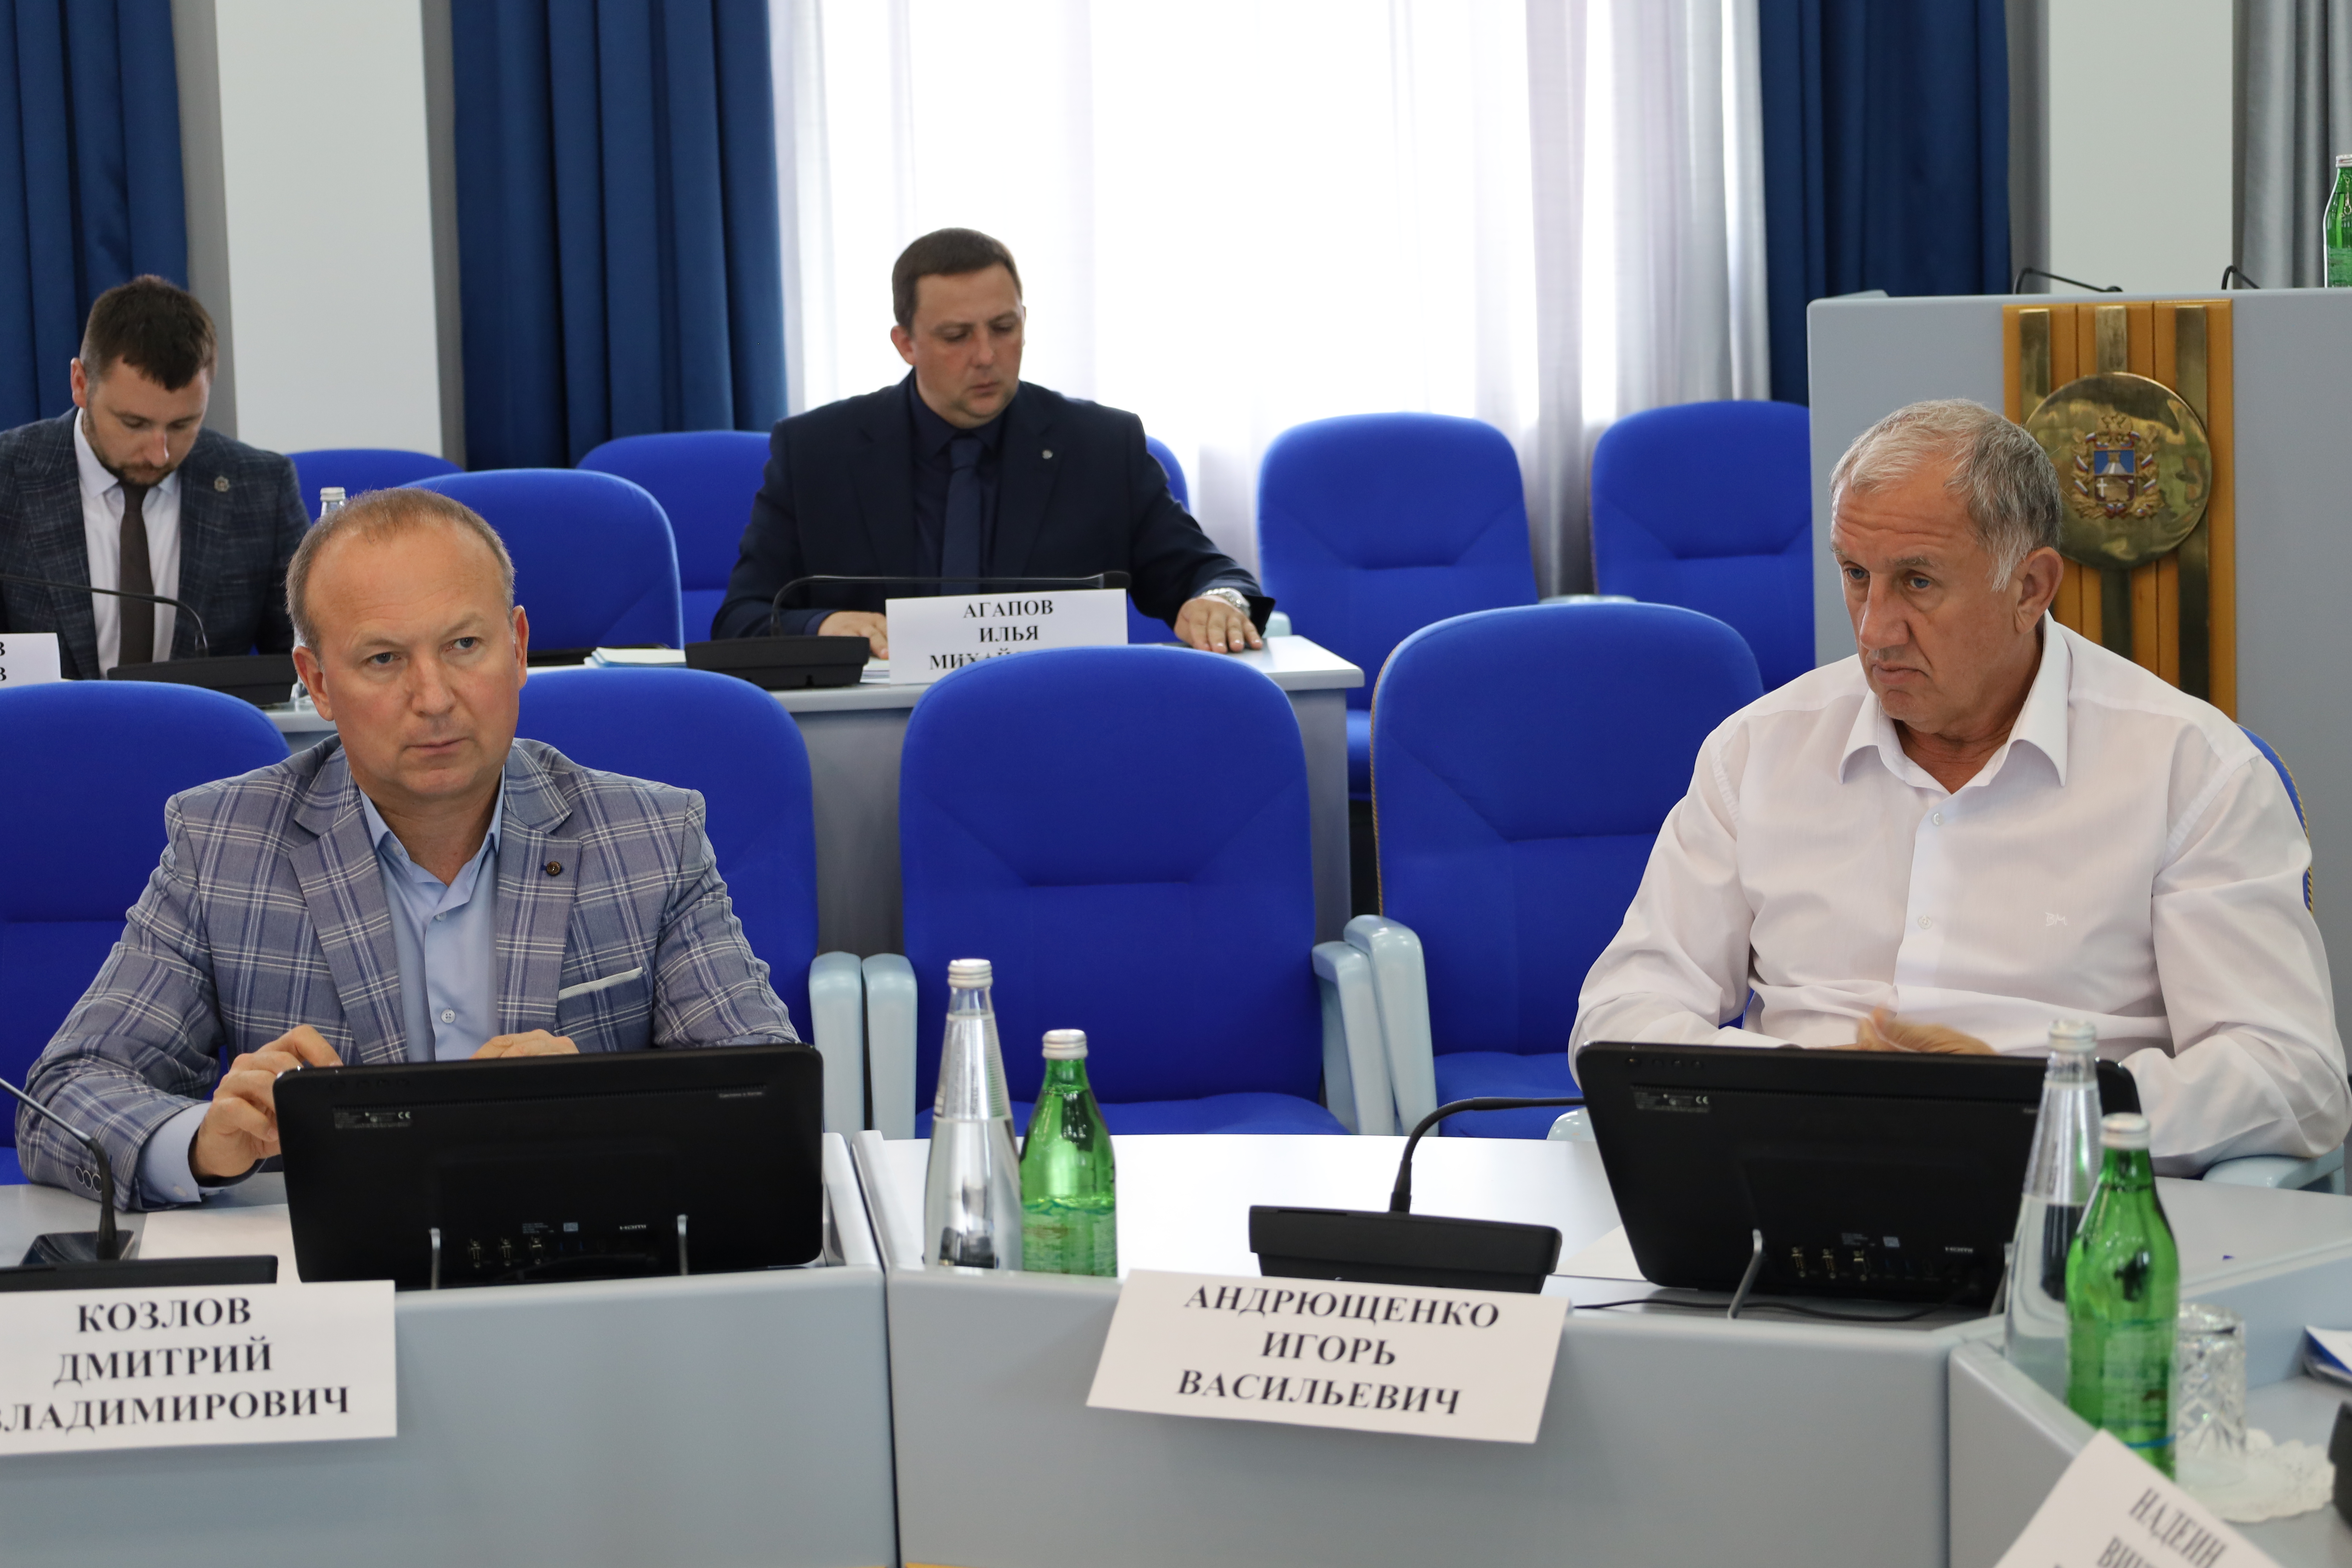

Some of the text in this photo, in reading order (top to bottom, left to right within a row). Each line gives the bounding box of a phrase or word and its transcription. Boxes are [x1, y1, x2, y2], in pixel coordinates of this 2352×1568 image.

[963, 599, 1054, 619] АГАПОВ
[979, 625, 1039, 643] ИЛЬЯ
[77, 1297, 251, 1334] КОЗЛОВ
[1184, 1285, 1500, 1328] АНДРЮЩЕНКО
[52, 1335, 272, 1389] ДМИТРИЙ
[1260, 1331, 1396, 1366] ИГОРЬ
[0, 1386, 350, 1434] ЛАДИМИРОВИЧ
[1176, 1369, 1461, 1415] ВАСИЛЬЕВИЧ
